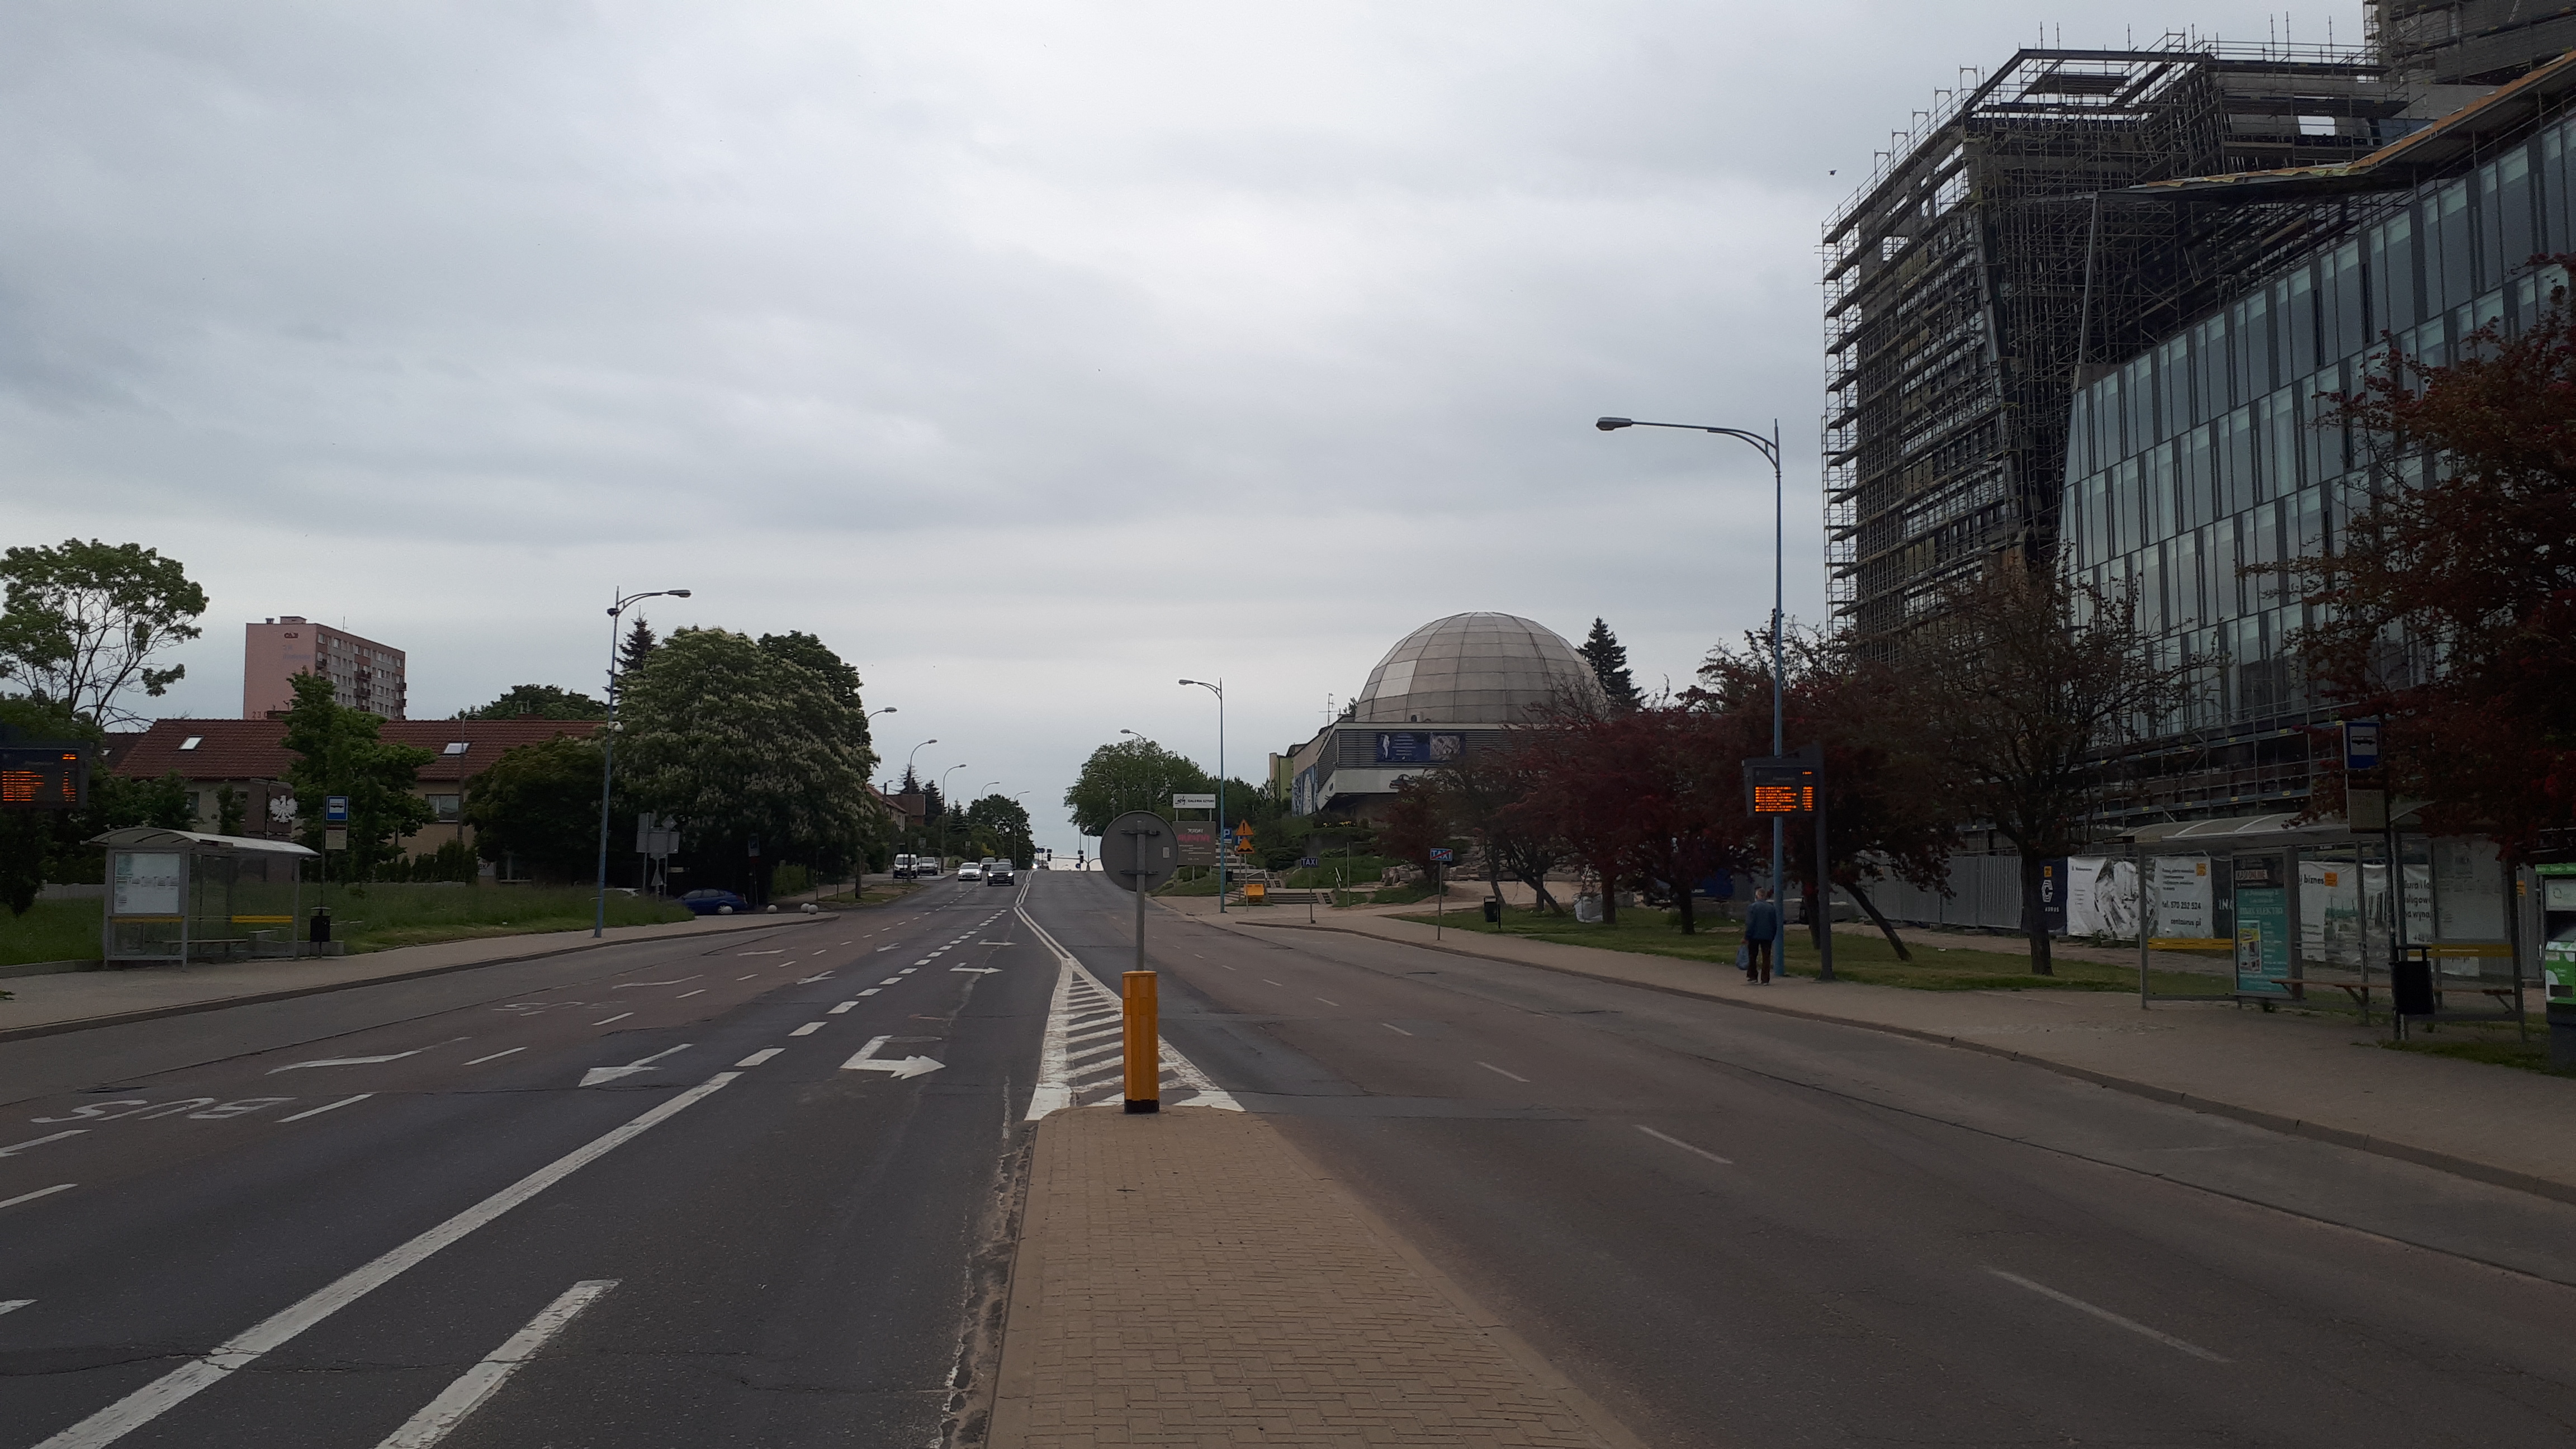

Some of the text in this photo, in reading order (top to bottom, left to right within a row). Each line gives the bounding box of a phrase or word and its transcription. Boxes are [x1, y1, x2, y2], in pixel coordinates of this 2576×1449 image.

[1224, 829, 1230, 837] P
[1431, 850, 1451, 859] TAXI
[2304, 874, 2324, 884] biznes
[31, 1097, 297, 1123] BUS
